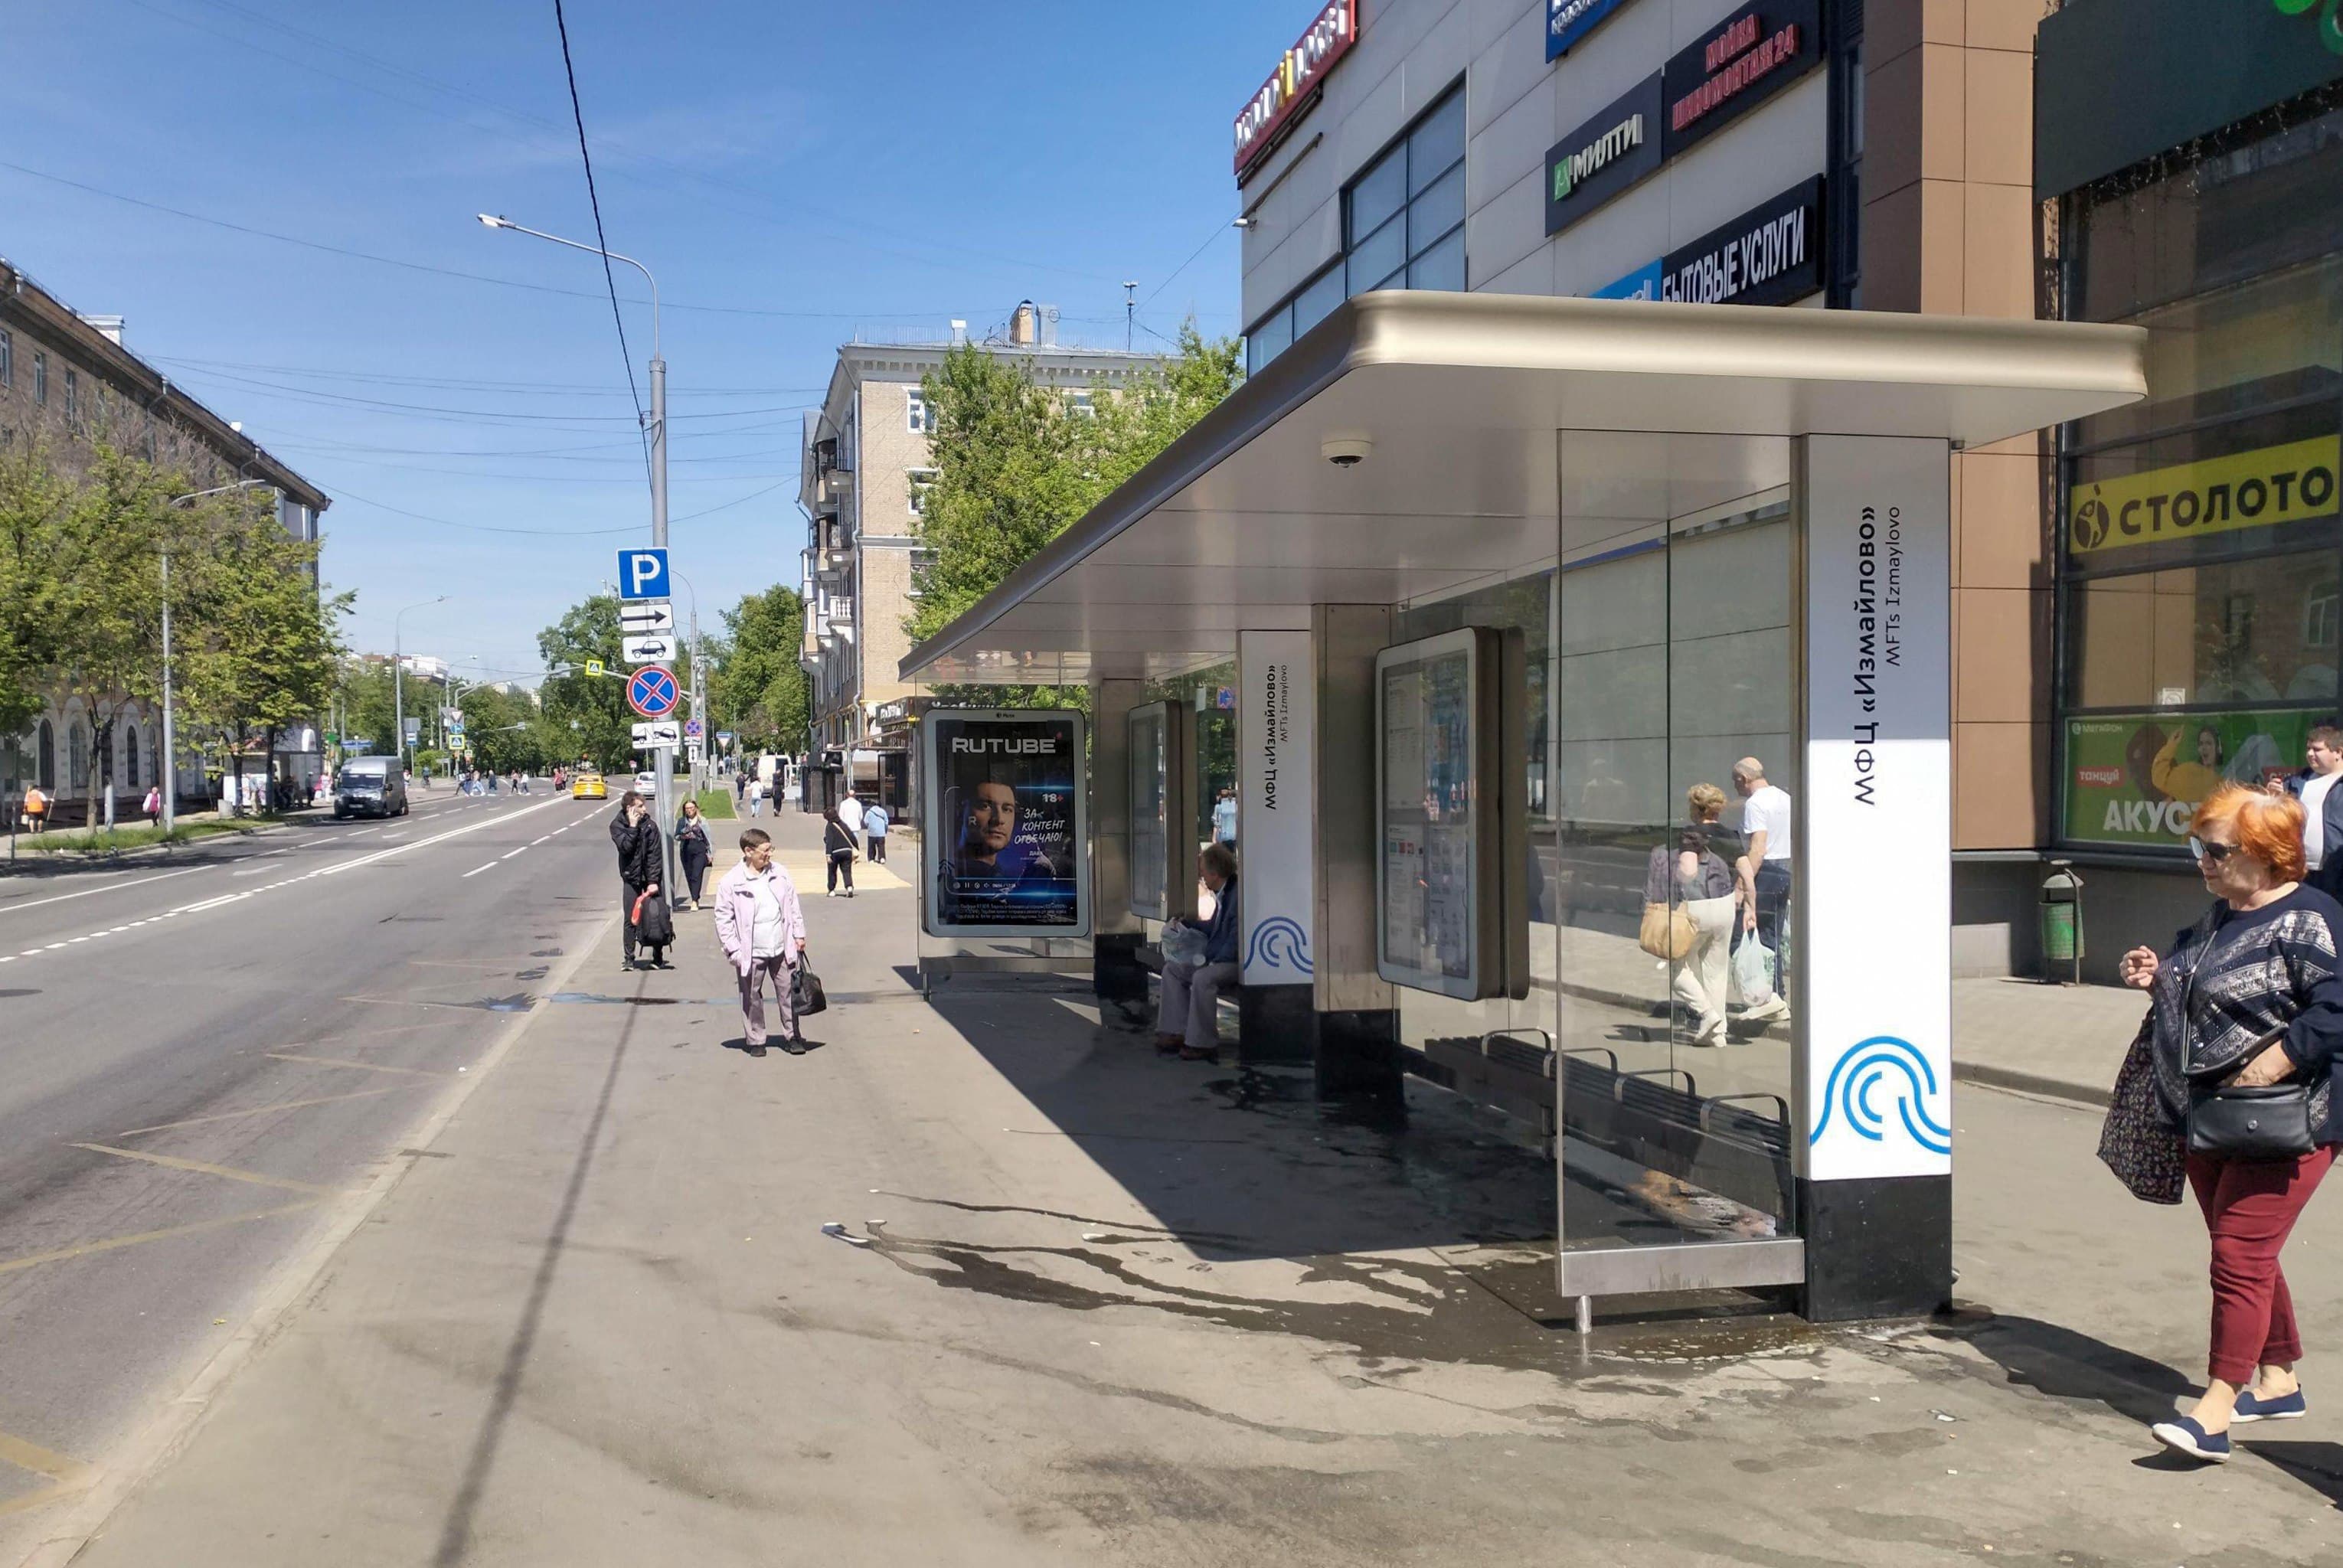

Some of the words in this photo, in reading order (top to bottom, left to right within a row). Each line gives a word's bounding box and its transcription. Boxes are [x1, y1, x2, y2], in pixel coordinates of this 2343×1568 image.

[1706, 13, 1759, 73] МОЙКА
[1672, 38, 1774, 131] ШИНОМОНТАЖ
[1773, 24, 1799, 64] 24
[1573, 113, 1642, 184] МИЛТИ
[1740, 205, 1804, 290] УСЛУГИ
[2119, 466, 2334, 536] СТОЛОТО
[1885, 506, 1903, 606] Izmaylovo
[1854, 506, 1875, 712] «Измайлово»
[1886, 613, 1900, 667] MFTs
[1265, 665, 1276, 765] «Измайлово»
[1279, 665, 1289, 713] Izmaylovo
[952, 737, 1056, 754] RUTUBE
[1854, 722, 1879, 805] МФЦ
[1024, 808, 1038, 818] ЗА
[1042, 793, 1064, 802] 18+
[1265, 769, 1278, 810] МФЦ
[1014, 831, 1064, 845] ОТВЕЧАЮ!
[1021, 819, 1066, 831] КОНТЕНТ
